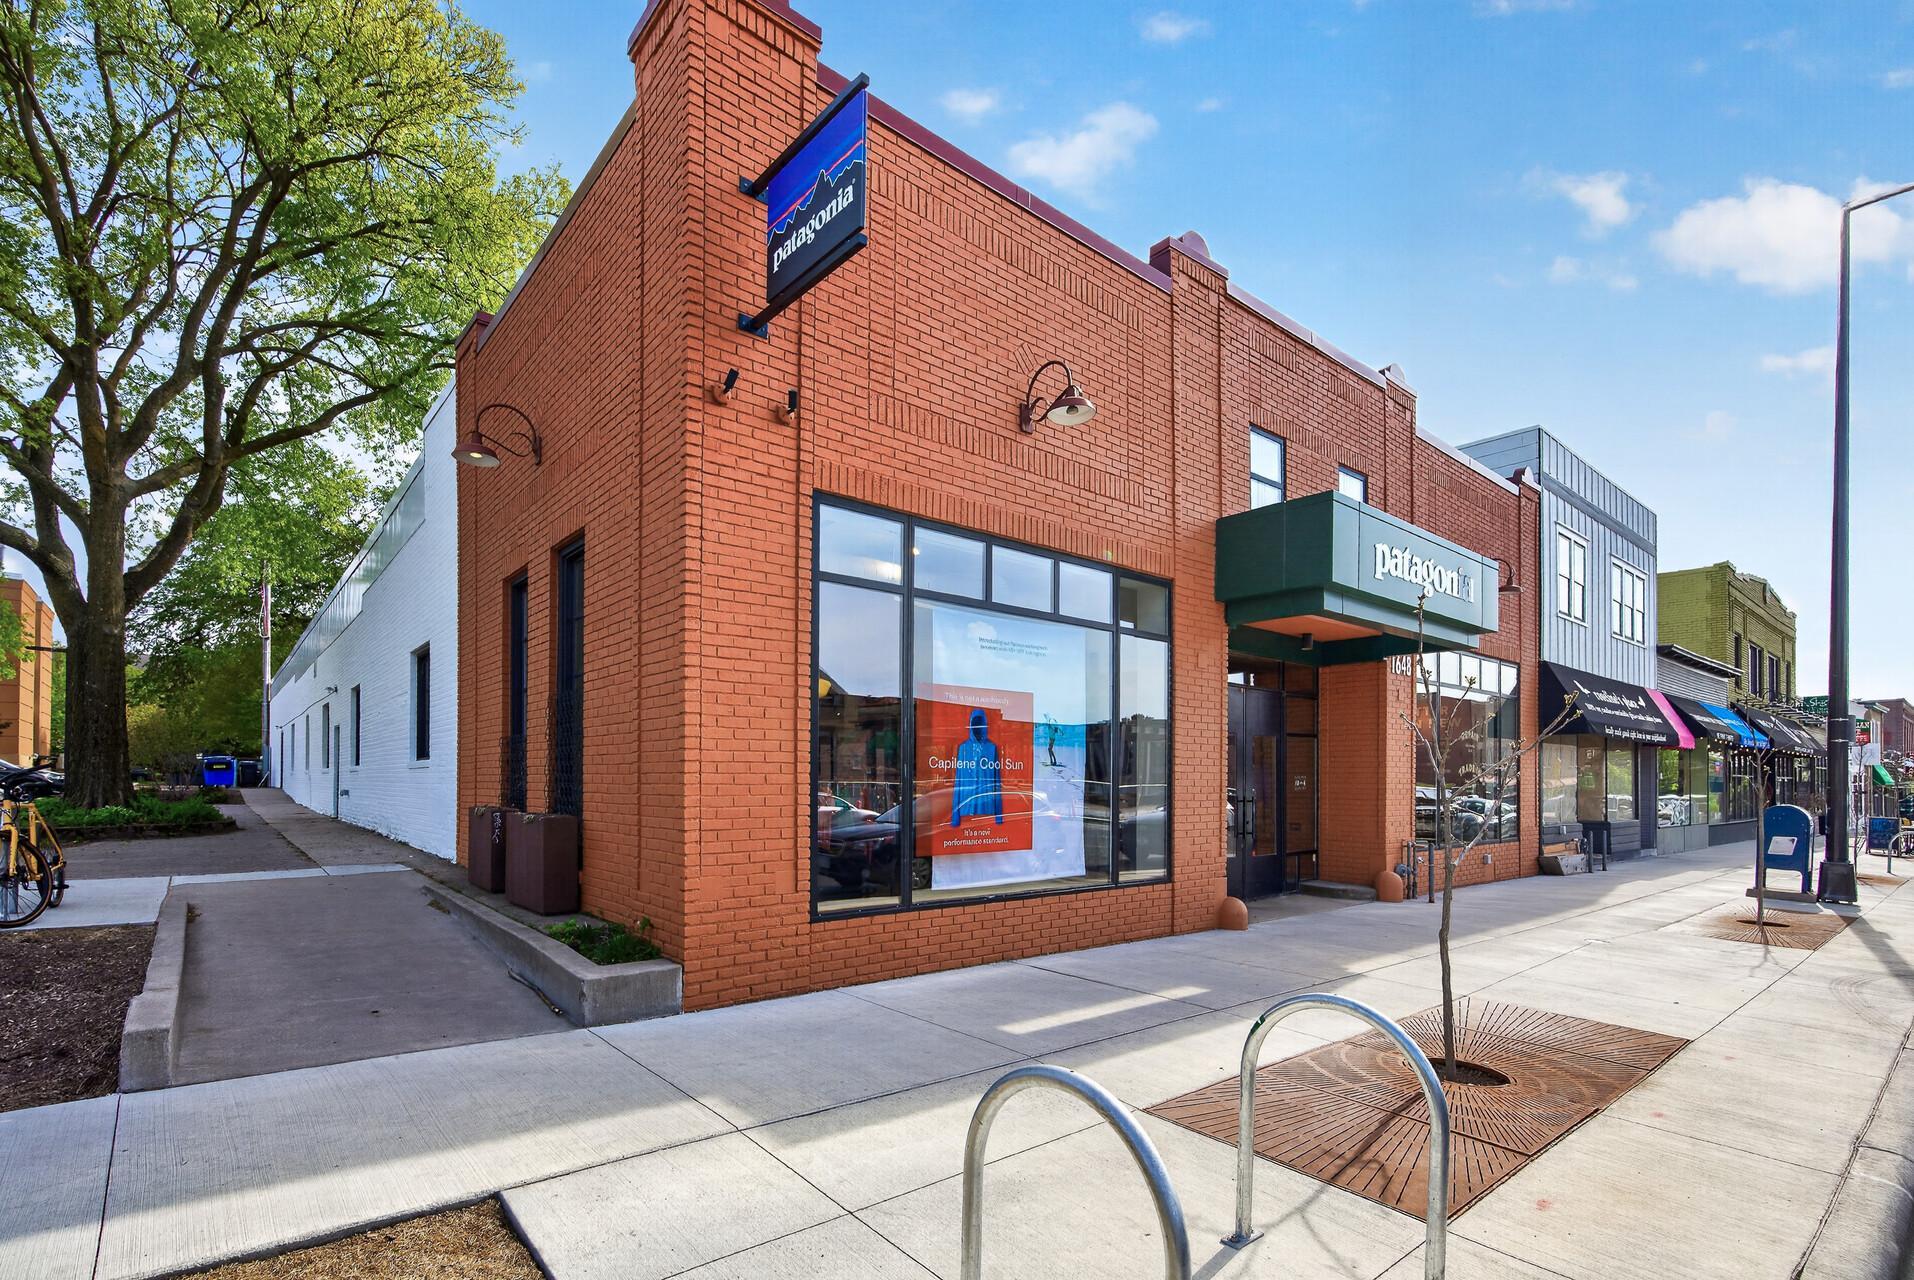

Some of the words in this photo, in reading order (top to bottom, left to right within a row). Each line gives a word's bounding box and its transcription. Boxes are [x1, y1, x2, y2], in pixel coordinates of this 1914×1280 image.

[773, 184, 854, 274] patagonia
[1374, 542, 1474, 603] patagonia
[1391, 655, 1411, 676] 1648
[928, 756, 976, 772] Capilene
[980, 756, 1003, 770] Cool
[1005, 757, 1024, 770] Sun
[943, 838, 982, 849] performance
